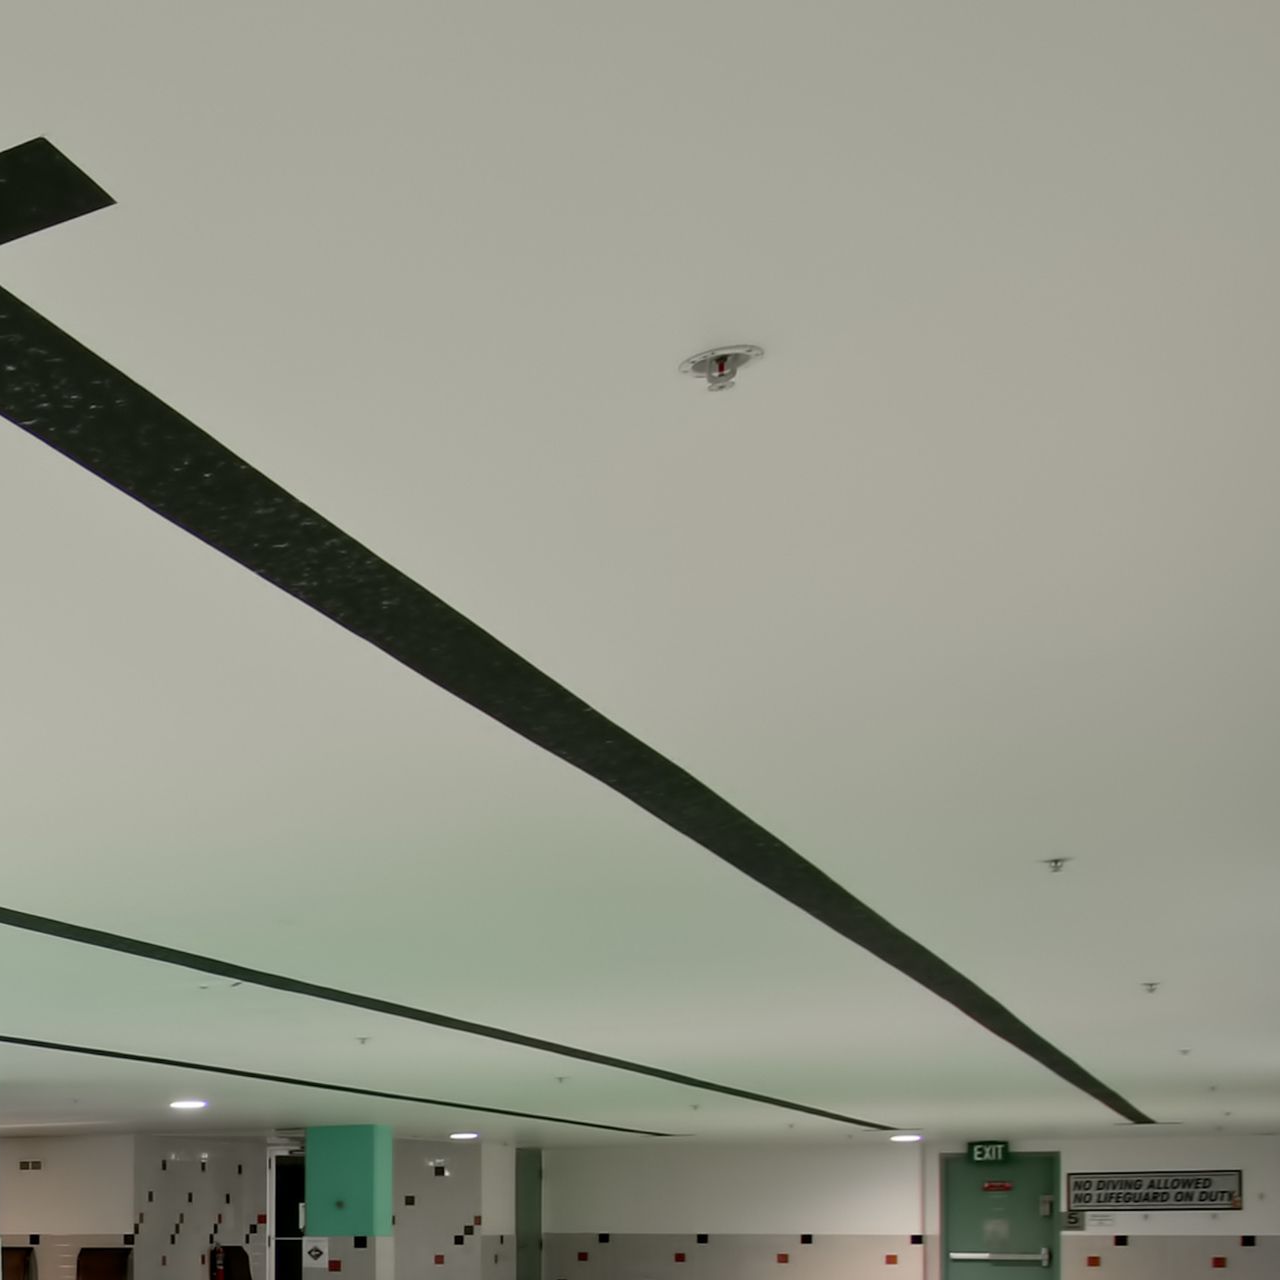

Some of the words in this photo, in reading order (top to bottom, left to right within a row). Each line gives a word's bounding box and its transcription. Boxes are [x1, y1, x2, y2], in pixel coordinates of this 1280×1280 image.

[973, 1144, 1005, 1161] EXIT
[1073, 1180, 1092, 1191] NO
[1096, 1179, 1143, 1191] DIVING
[1147, 1178, 1213, 1190] ALLOWED
[1072, 1192, 1091, 1204] NO
[1095, 1191, 1170, 1204] LIFEGUARD
[1174, 1191, 1195, 1203] ON
[1198, 1190, 1235, 1202] DUTY
